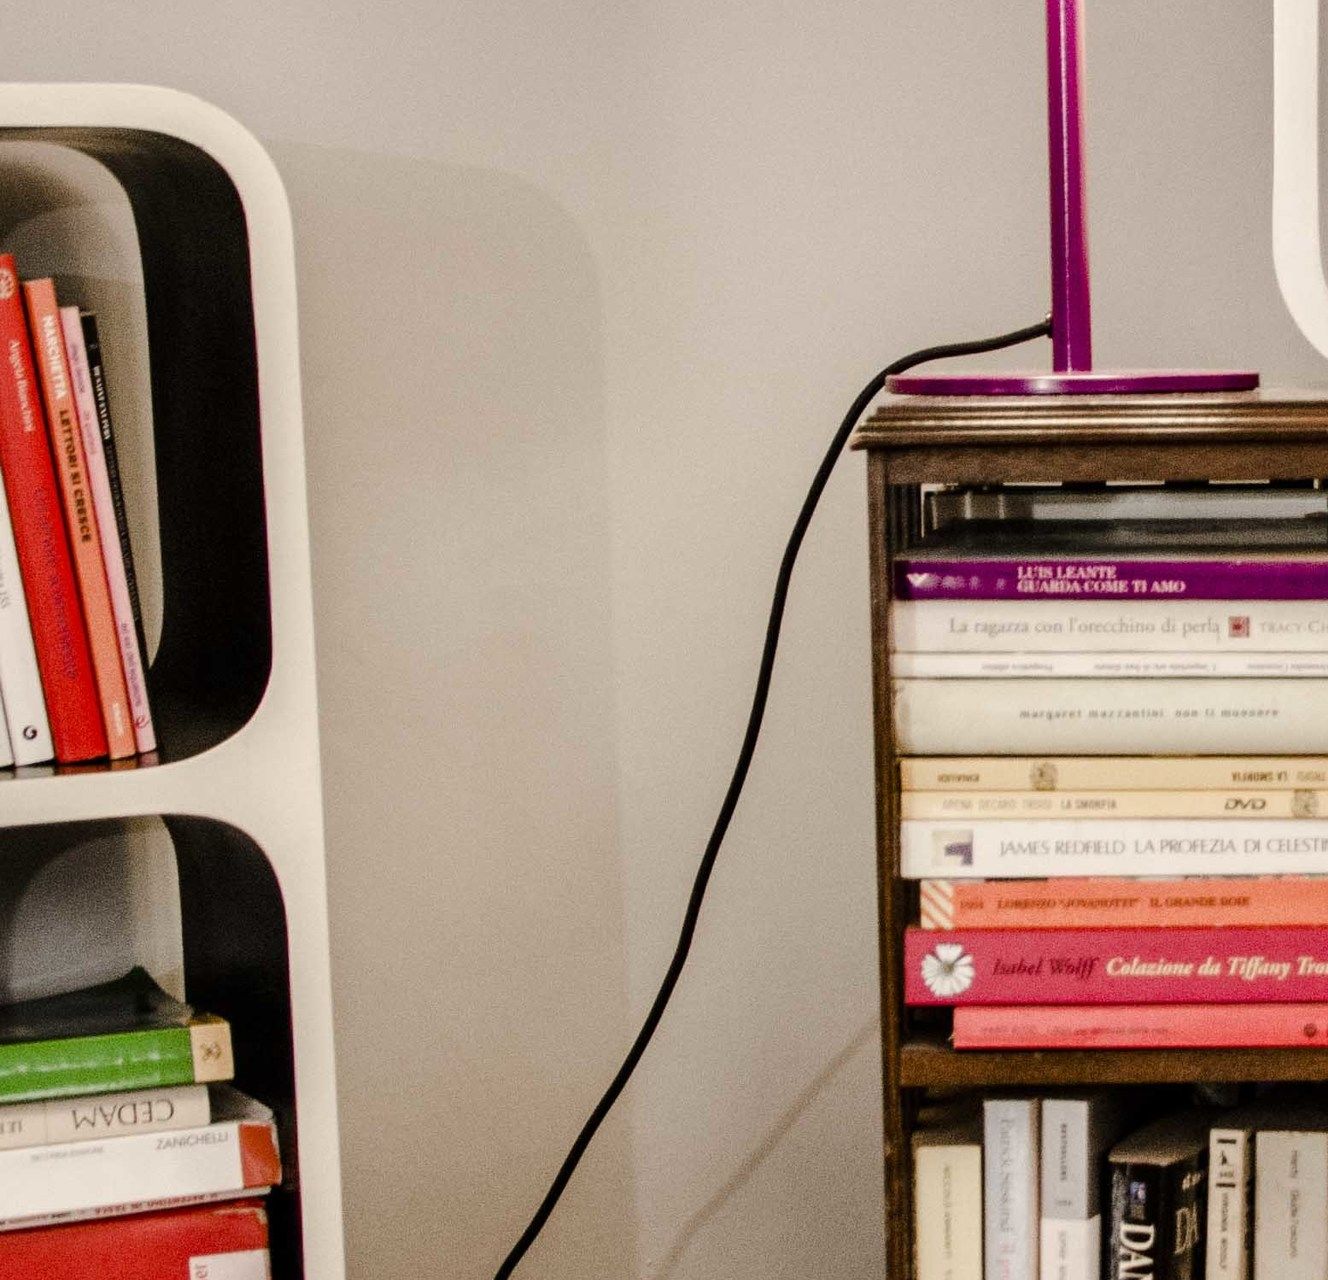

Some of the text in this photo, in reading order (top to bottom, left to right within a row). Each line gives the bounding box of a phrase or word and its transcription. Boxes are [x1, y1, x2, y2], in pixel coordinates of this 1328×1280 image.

[58, 409, 78, 468] LETTORI
[69, 471, 81, 484] SI
[72, 487, 92, 542] CRESCE
[1017, 566, 1116, 578] LUIS LEANTE
[1016, 580, 1082, 593] GUARDA
[1084, 580, 1126, 593] COME
[1131, 580, 1146, 592] TI
[1151, 580, 1185, 592] AMO
[949, 617, 1219, 639] La ragazza con l'orecchino di perla
[1261, 621, 1301, 633] TRACY
[1224, 798, 1266, 810] DVD
[1000, 840, 1050, 855] JAMES
[1054, 839, 1126, 854] REDFIELD
[1134, 839, 1155, 854] LA
[1159, 838, 1237, 854] PROFEZIA
[1244, 838, 1260, 853] DI
[997, 898, 1056, 909] LORENZO
[1149, 896, 1161, 907] IL
[1164, 896, 1217, 906] GRANDE
[991, 957, 1043, 974] Isabel
[1047, 957, 1099, 978] Wolff
[1105, 956, 1193, 975] Colazione
[1198, 956, 1222, 975] da
[1228, 956, 1292, 980] Tiffany
[70, 1097, 176, 1132] CEDAM
[154, 1129, 230, 1151] ZANICHELLI
